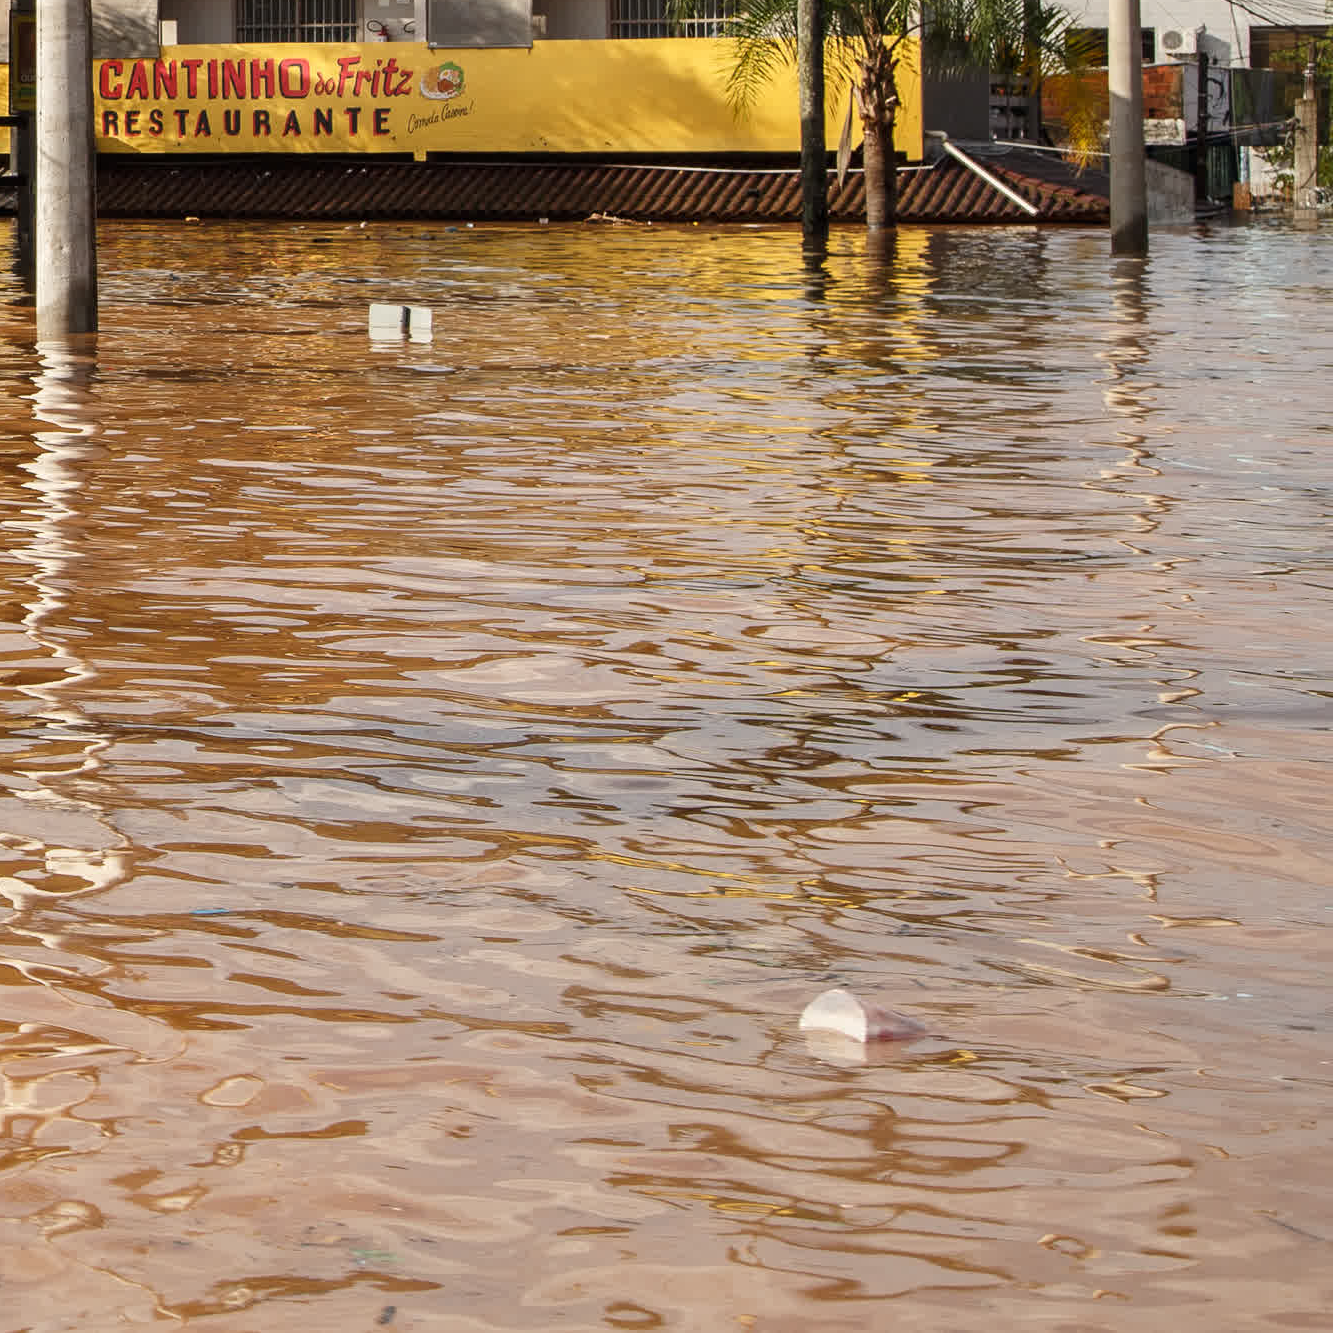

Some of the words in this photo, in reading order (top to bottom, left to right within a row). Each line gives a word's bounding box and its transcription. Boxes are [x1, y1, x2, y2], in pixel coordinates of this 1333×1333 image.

[98, 57, 311, 100] CANTINHO
[315, 70, 335, 95] do
[335, 55, 414, 98] Fritz
[101, 107, 392, 137] RESTAURANTE
